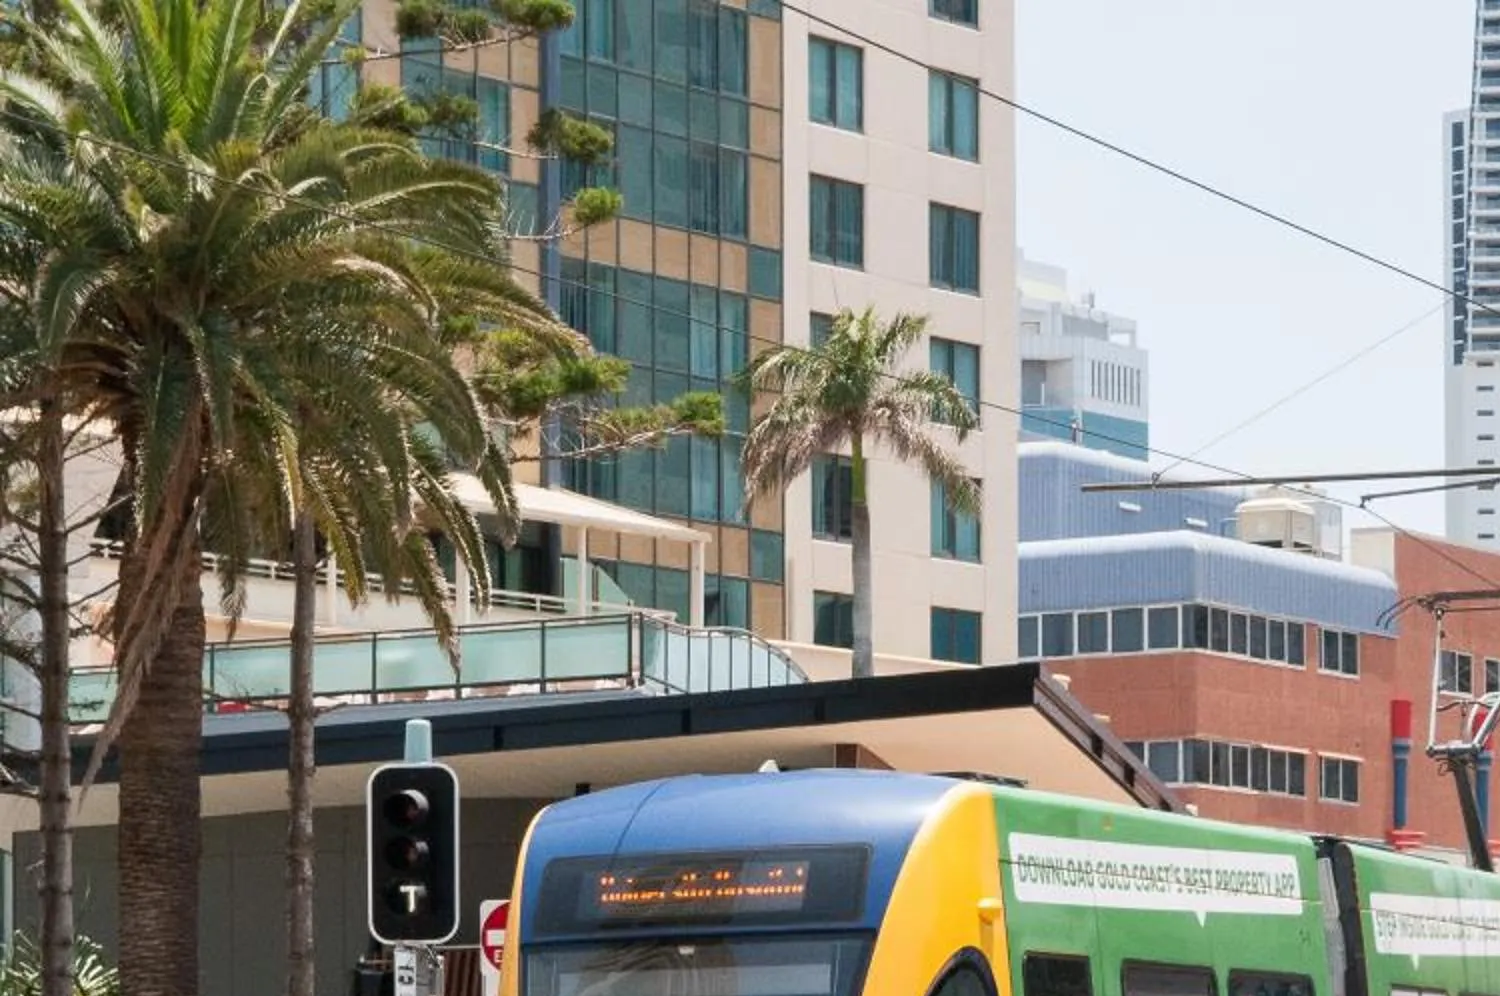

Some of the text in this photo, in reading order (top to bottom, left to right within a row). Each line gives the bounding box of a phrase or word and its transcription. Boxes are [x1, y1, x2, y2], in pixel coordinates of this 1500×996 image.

[1017, 854, 1094, 889] DOWNLOAD
[1099, 861, 1131, 891] GOLD
[1275, 872, 1296, 898] APP
